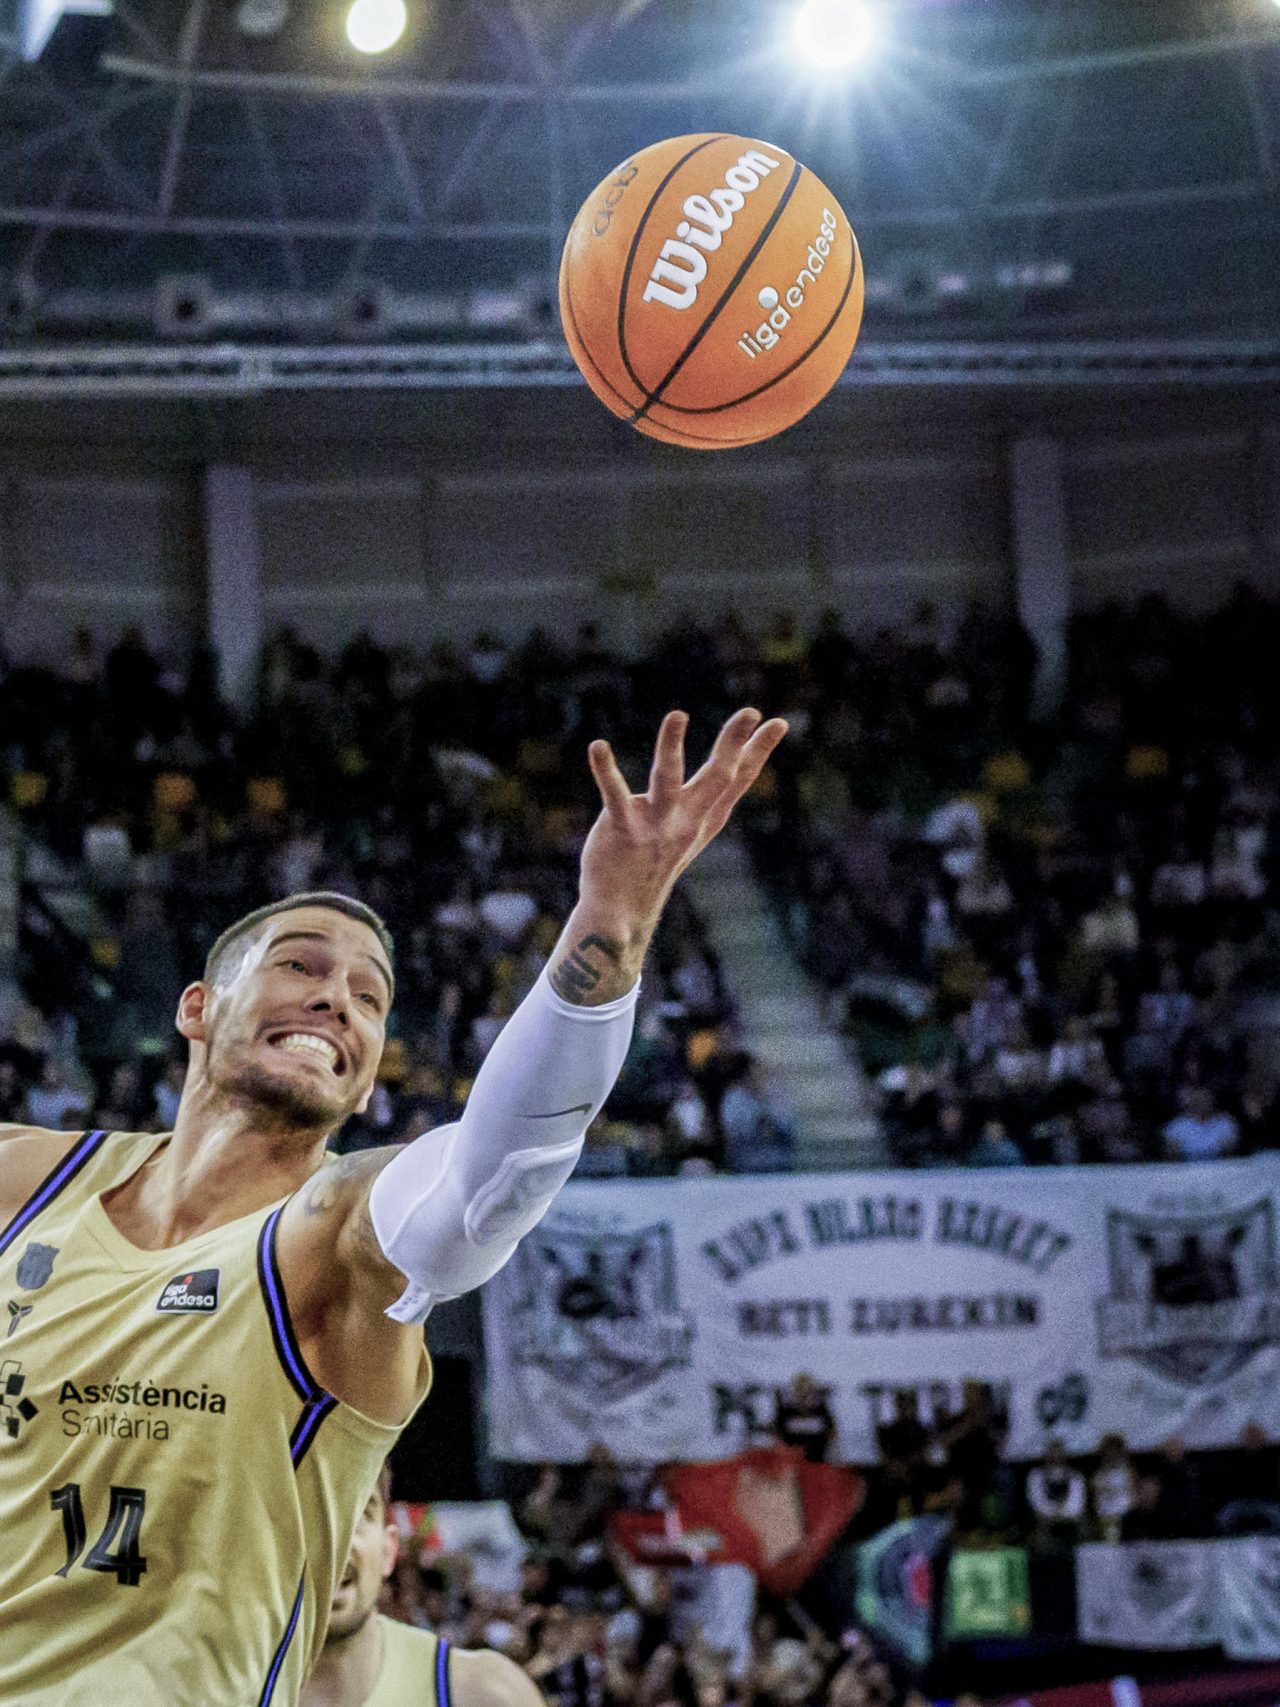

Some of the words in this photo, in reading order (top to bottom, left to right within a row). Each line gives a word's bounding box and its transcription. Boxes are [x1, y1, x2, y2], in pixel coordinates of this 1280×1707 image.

[642, 150, 780, 310] Wilson
[737, 304, 792, 359] liga
[785, 207, 837, 308] endesa
[160, 1293, 215, 1308] endesa
[58, 1377, 227, 1415] Assistència
[49, 1482, 148, 1587] 14
